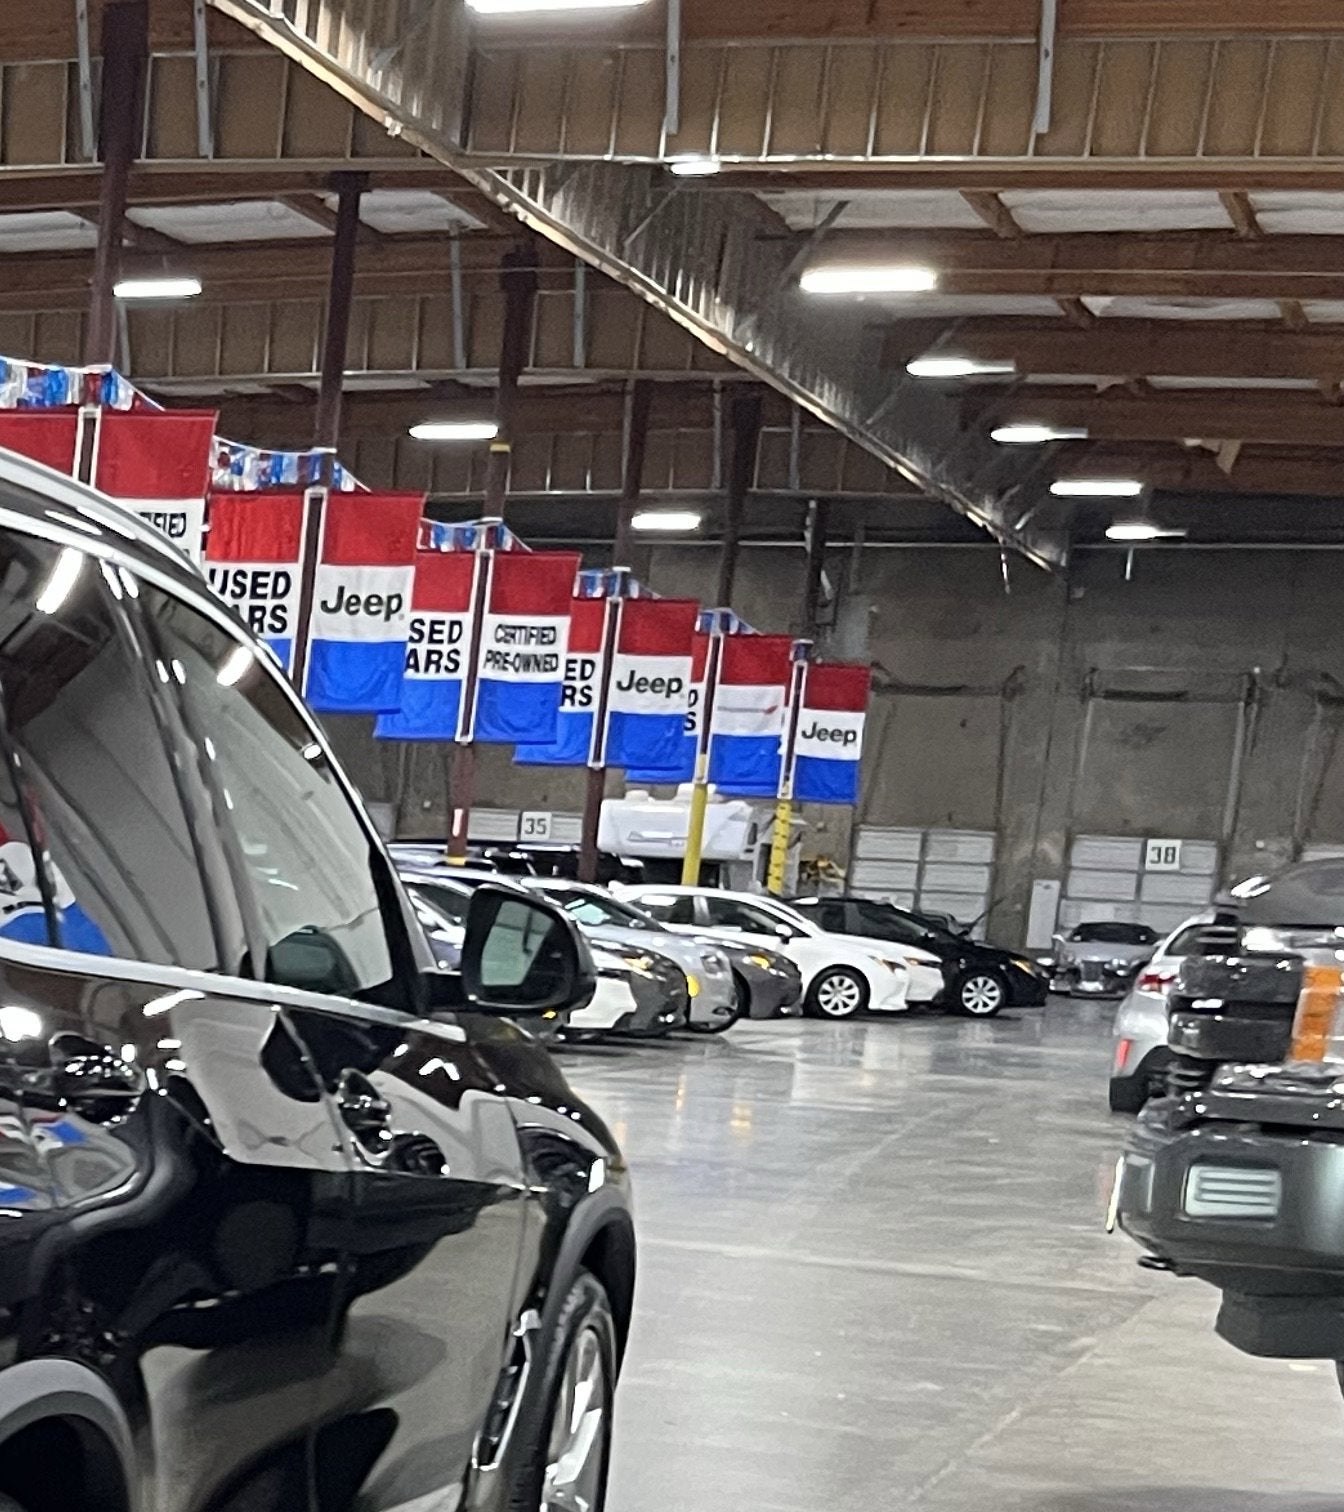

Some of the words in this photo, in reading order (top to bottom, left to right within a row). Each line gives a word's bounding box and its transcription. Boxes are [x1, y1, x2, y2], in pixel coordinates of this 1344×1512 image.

[320, 585, 403, 623] Jeep
[408, 618, 463, 645] SED
[493, 623, 557, 646] CERTIFIED
[405, 647, 461, 674] ARS
[483, 648, 559, 673] PRE-OWNED
[564, 658, 596, 682] ED
[561, 684, 593, 707] RS
[616, 669, 683, 699] Jeep
[801, 721, 857, 747] Jeep
[524, 817, 548, 836] 35
[1149, 845, 1177, 865] 38
